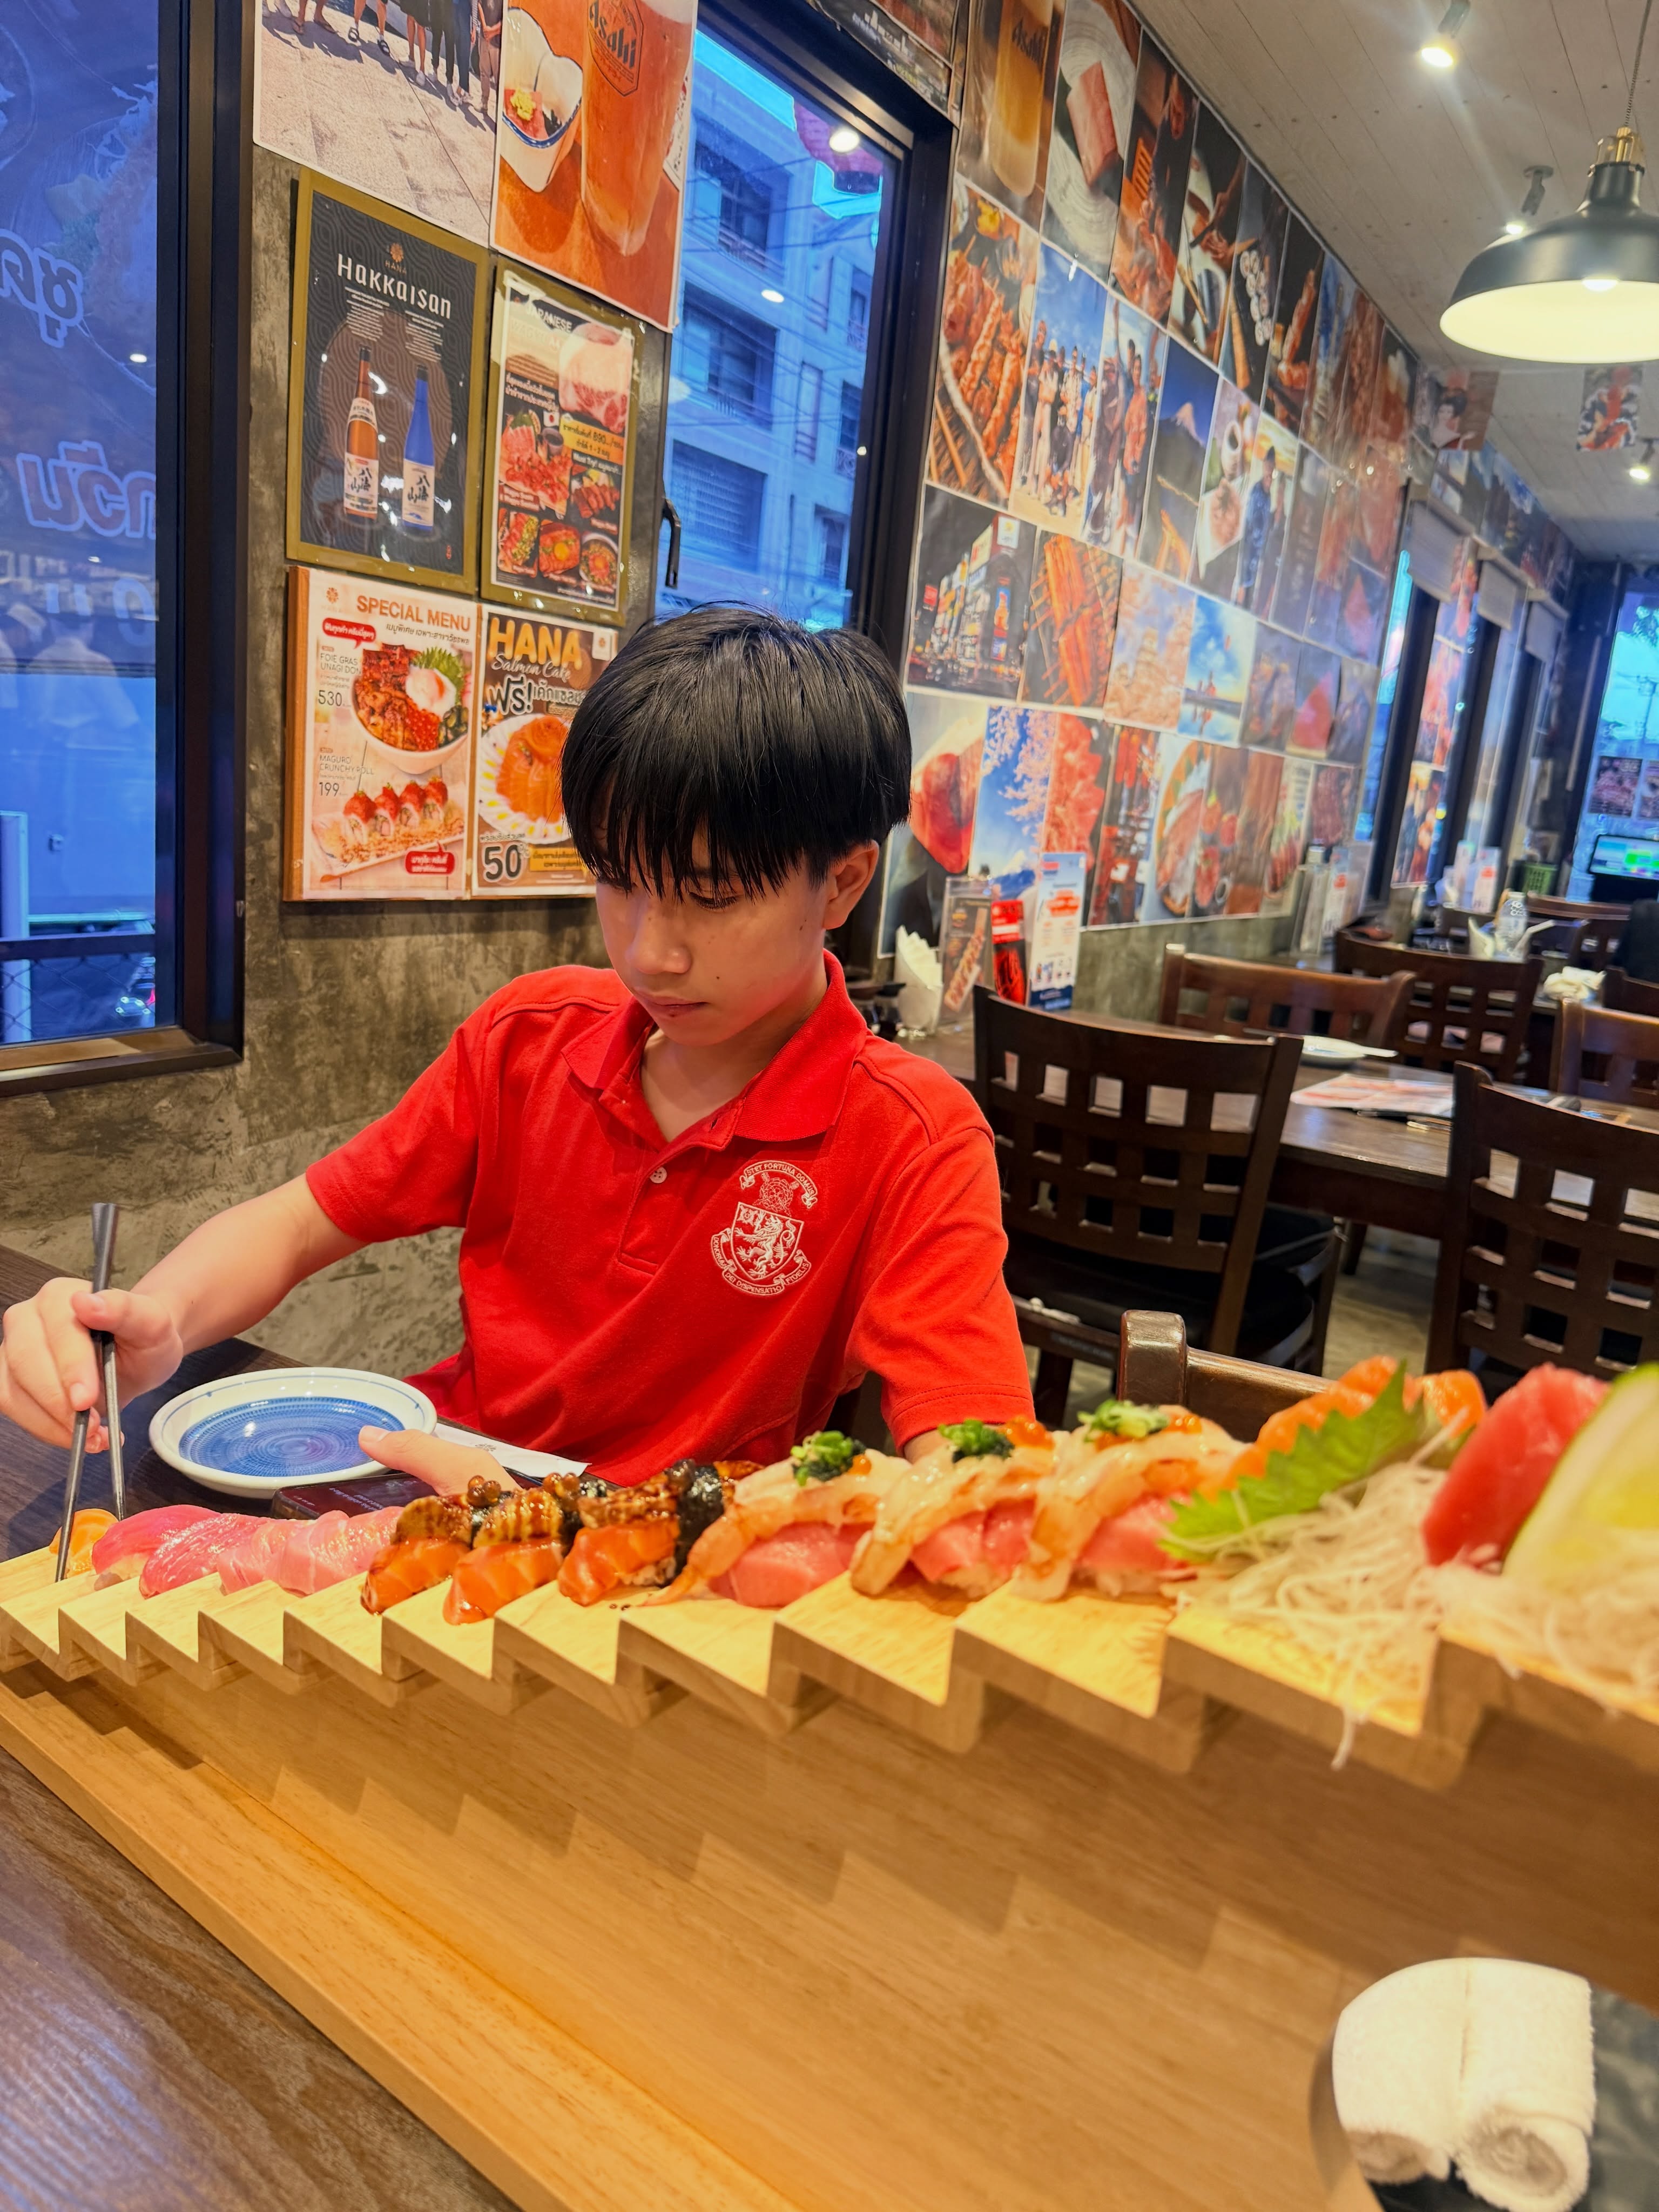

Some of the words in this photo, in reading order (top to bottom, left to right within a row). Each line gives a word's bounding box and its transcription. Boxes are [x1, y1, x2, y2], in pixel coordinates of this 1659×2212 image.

[385, 261, 407, 274] HANA
[527, 305, 572, 332] JAPANESE
[356, 595, 424, 623] SPECIAL
[428, 609, 471, 632] MENU
[488, 617, 582, 670] HANA
[320, 653, 337, 663] FOIE
[339, 656, 358, 665] GRAS
[320, 663, 343, 672] UNAGI
[345, 666, 361, 675] DON
[491, 653, 541, 676] Salmon
[542, 660, 571, 683] Cake
[320, 755, 352, 764] MAGURO
[320, 764, 355, 772] CRUNCHY
[746, 1164, 763, 1175] STET
[764, 1163, 795, 1175] FORTUNA
[796, 1172, 815, 1195] DOMUS
[713, 1237, 728, 1269] DONORUM
[725, 1272, 736, 1283] DEI
[736, 1281, 782, 1294] DISPENSATIO
[785, 1263, 809, 1284] FIDELIS
